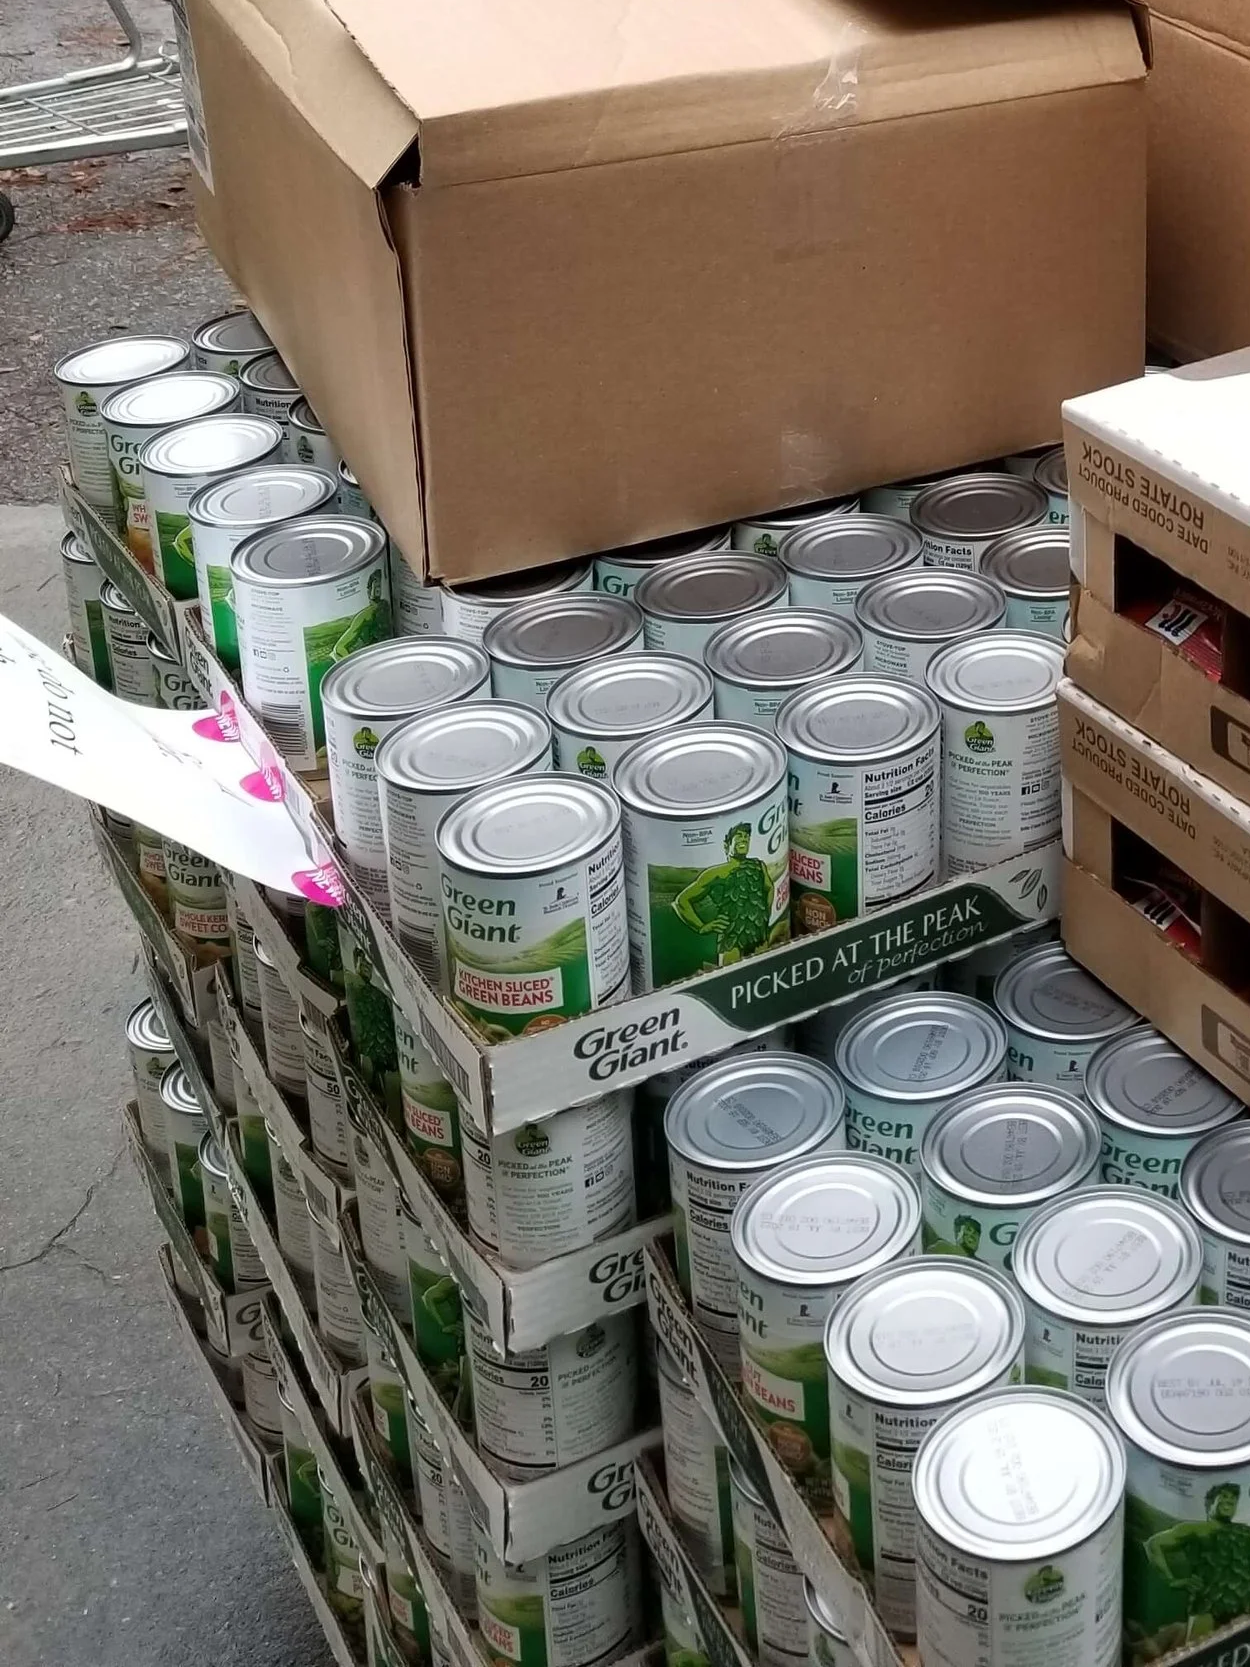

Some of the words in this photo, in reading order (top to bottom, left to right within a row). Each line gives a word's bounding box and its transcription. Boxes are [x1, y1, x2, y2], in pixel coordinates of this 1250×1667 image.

[1082, 442, 1136, 488] STOCK
[1078, 462, 1131, 507] PRODUCT
[1132, 500, 1175, 533] CODED
[1140, 474, 1206, 530] ROTATE
[1177, 526, 1209, 556] DATE
[876, 639, 907, 652] STOVE-TOP
[47, 700, 84, 756] not
[1075, 717, 1128, 770] STOCK
[864, 762, 914, 784] Nutrition
[915, 747, 935, 768] Facts
[948, 751, 976, 765] PICKED
[991, 760, 1012, 768] PEAK
[958, 765, 1006, 777] PERFECTION
[1071, 739, 1125, 784] PRODUCT
[1124, 777, 1167, 818] CODED
[1131, 756, 1191, 818] ROTATE
[864, 804, 907, 821] Calories
[1167, 810, 1198, 841] DATE
[682, 829, 713, 839] Non-BPA
[441, 874, 516, 917] Green
[590, 884, 622, 915] Calories
[446, 910, 522, 945] Giant
[731, 956, 825, 1010] PICKED
[831, 940, 866, 973] AT
[868, 924, 916, 957] THE
[922, 894, 983, 936] PEAK
[847, 964, 874, 985] of
[876, 918, 990, 982] perfection
[458, 967, 504, 992] KITCHEN
[505, 974, 554, 992] SLICED
[458, 982, 501, 1007] GREEN
[501, 989, 555, 1008] BEANS
[574, 1006, 680, 1061] Green
[589, 1028, 682, 1082] Giant
[326, 1083, 340, 1095] 50
[477, 1149, 491, 1165] 20
[549, 1156, 573, 1167] PEAK
[1102, 1132, 1181, 1176] Green
[510, 1166, 570, 1180] PERFECTION
[687, 1171, 744, 1193] Nutrition
[689, 1208, 730, 1231] Calories
[530, 1375, 549, 1389] 20
[547, 1539, 600, 1565] Nutrition
[951, 1555, 988, 1580] Facts
[549, 1577, 596, 1599] Calories
[967, 1603, 988, 1623] 20
